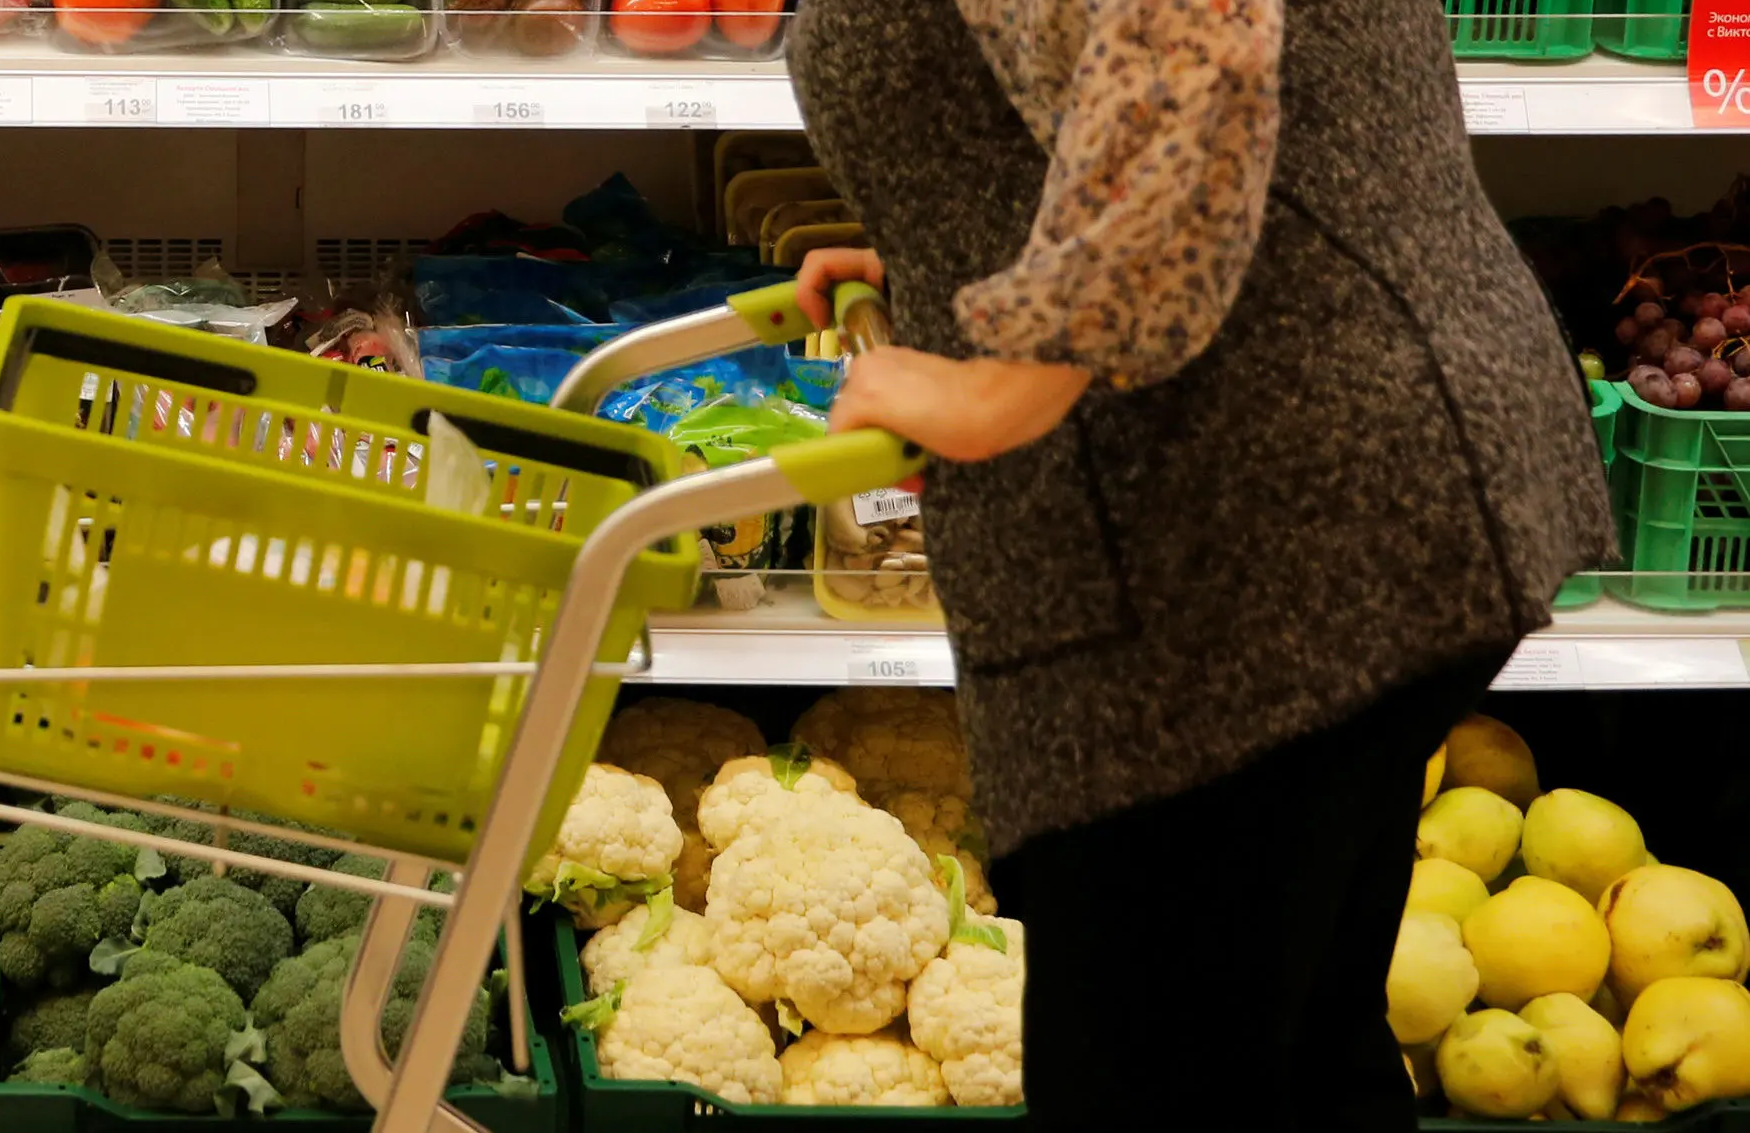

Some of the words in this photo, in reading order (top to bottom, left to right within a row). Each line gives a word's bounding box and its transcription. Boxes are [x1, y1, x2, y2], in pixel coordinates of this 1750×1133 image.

[1707, 28, 1715, 37] с
[104, 99, 141, 115] 113
[339, 103, 373, 120] 181
[494, 102, 530, 118] 156
[665, 101, 702, 117] 122
[868, 661, 905, 677] 105
